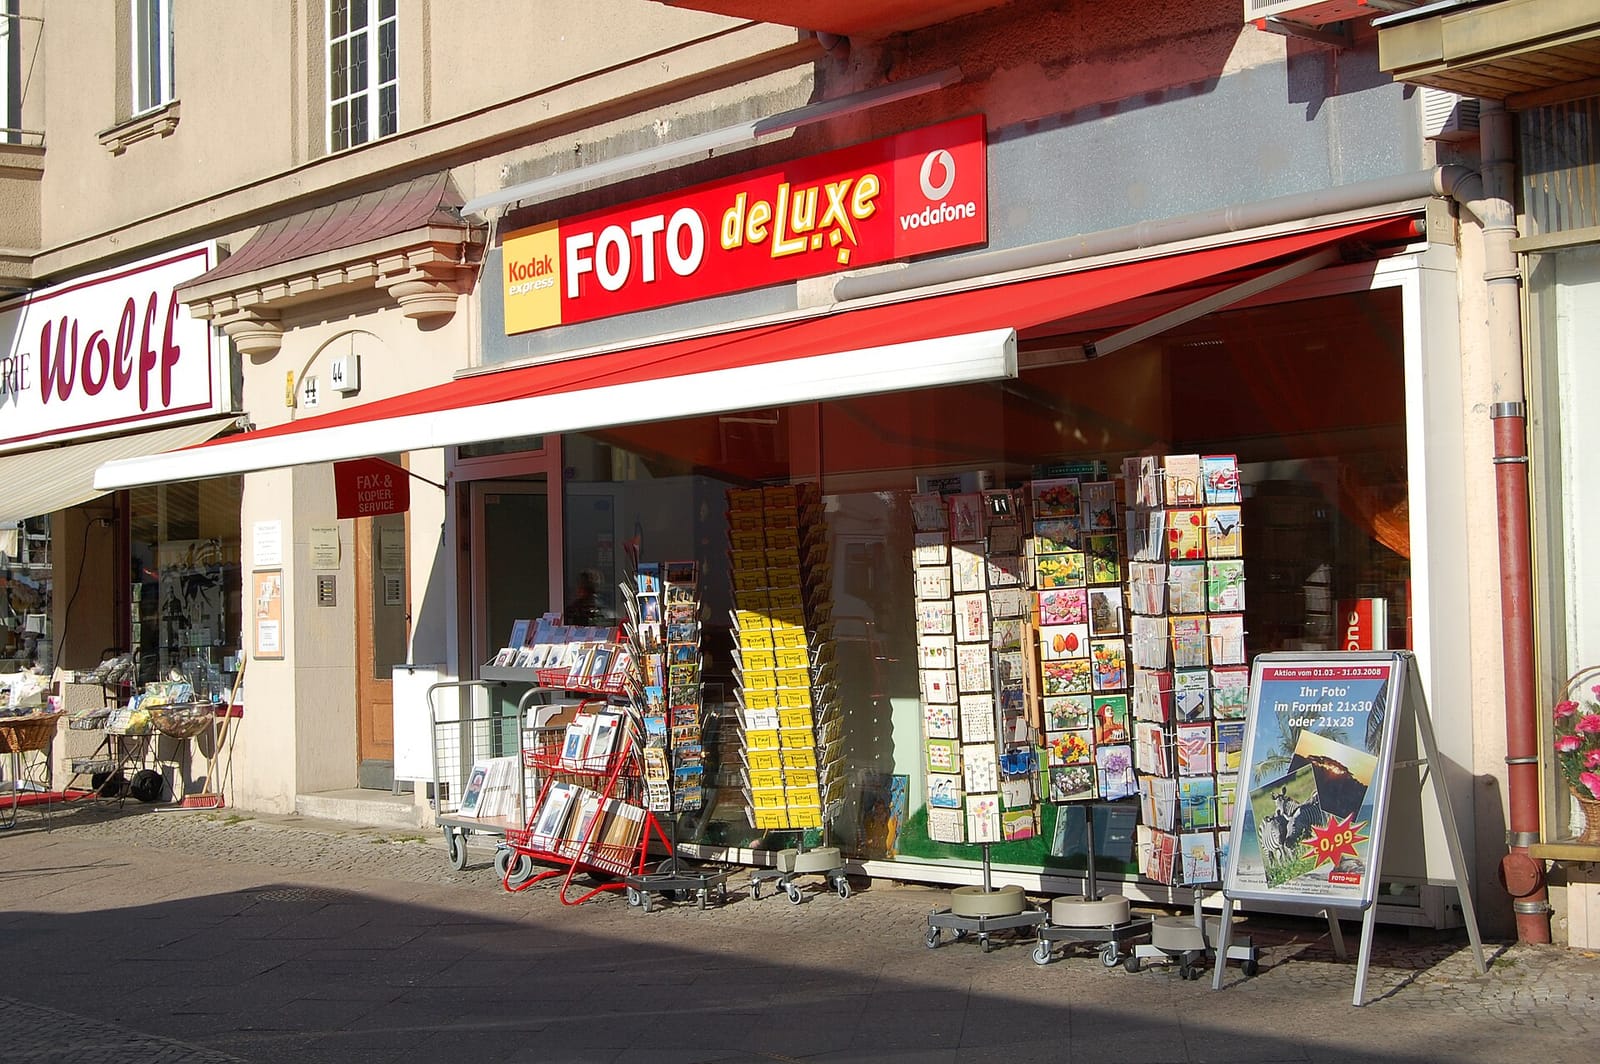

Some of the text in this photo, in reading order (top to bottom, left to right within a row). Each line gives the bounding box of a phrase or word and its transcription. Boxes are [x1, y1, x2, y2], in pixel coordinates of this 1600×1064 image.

[900, 201, 977, 231] vodafone
[565, 173, 880, 299] FOTO deLuxe
[508, 254, 554, 283] Kodak
[508, 276, 555, 296] express
[40, 290, 181, 412] Wolff
[332, 361, 343, 383] 44
[358, 500, 395, 513] SERVICE
[1273, 669, 1297, 677] Aktion
[1299, 686, 1319, 697] Ihr
[1274, 701, 1373, 712] im Format 21x30
[1288, 716, 1355, 727] oder 21x28
[1320, 830, 1353, 852] 0,99
